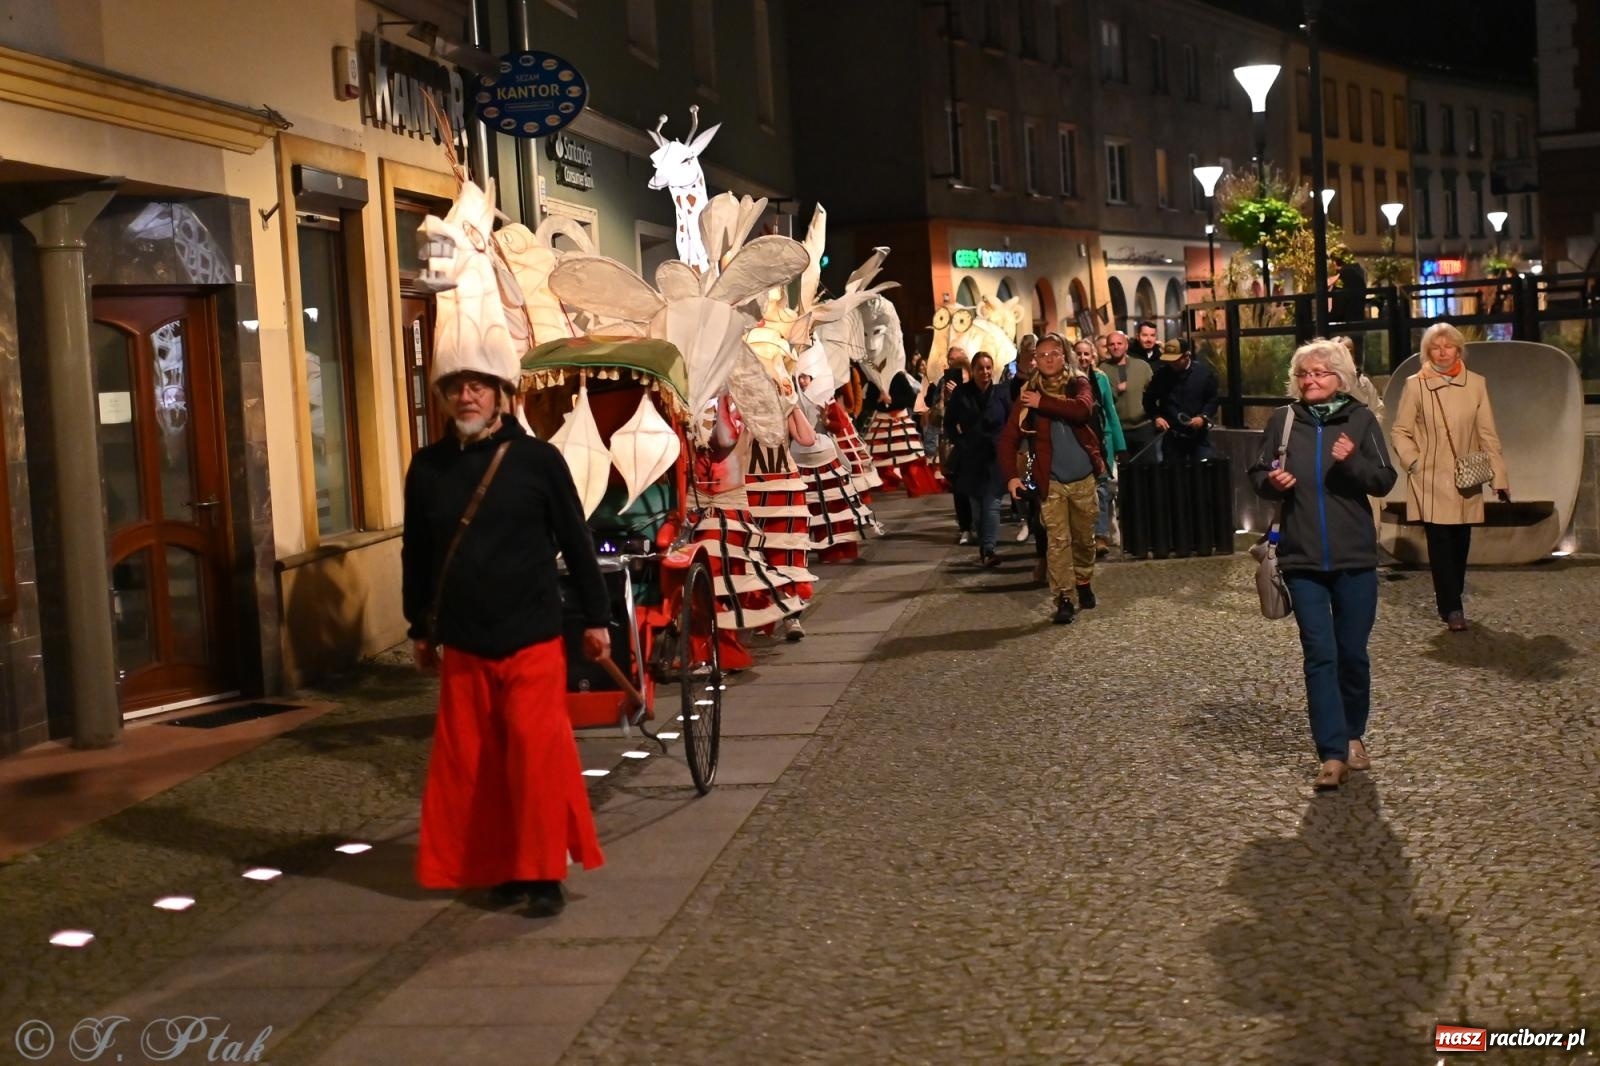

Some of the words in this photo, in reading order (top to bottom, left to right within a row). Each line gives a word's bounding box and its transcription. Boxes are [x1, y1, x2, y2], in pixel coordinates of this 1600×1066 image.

[515, 74, 540, 82] SEZAM
[497, 83, 560, 99] KANTOR
[564, 136, 592, 167] Santander
